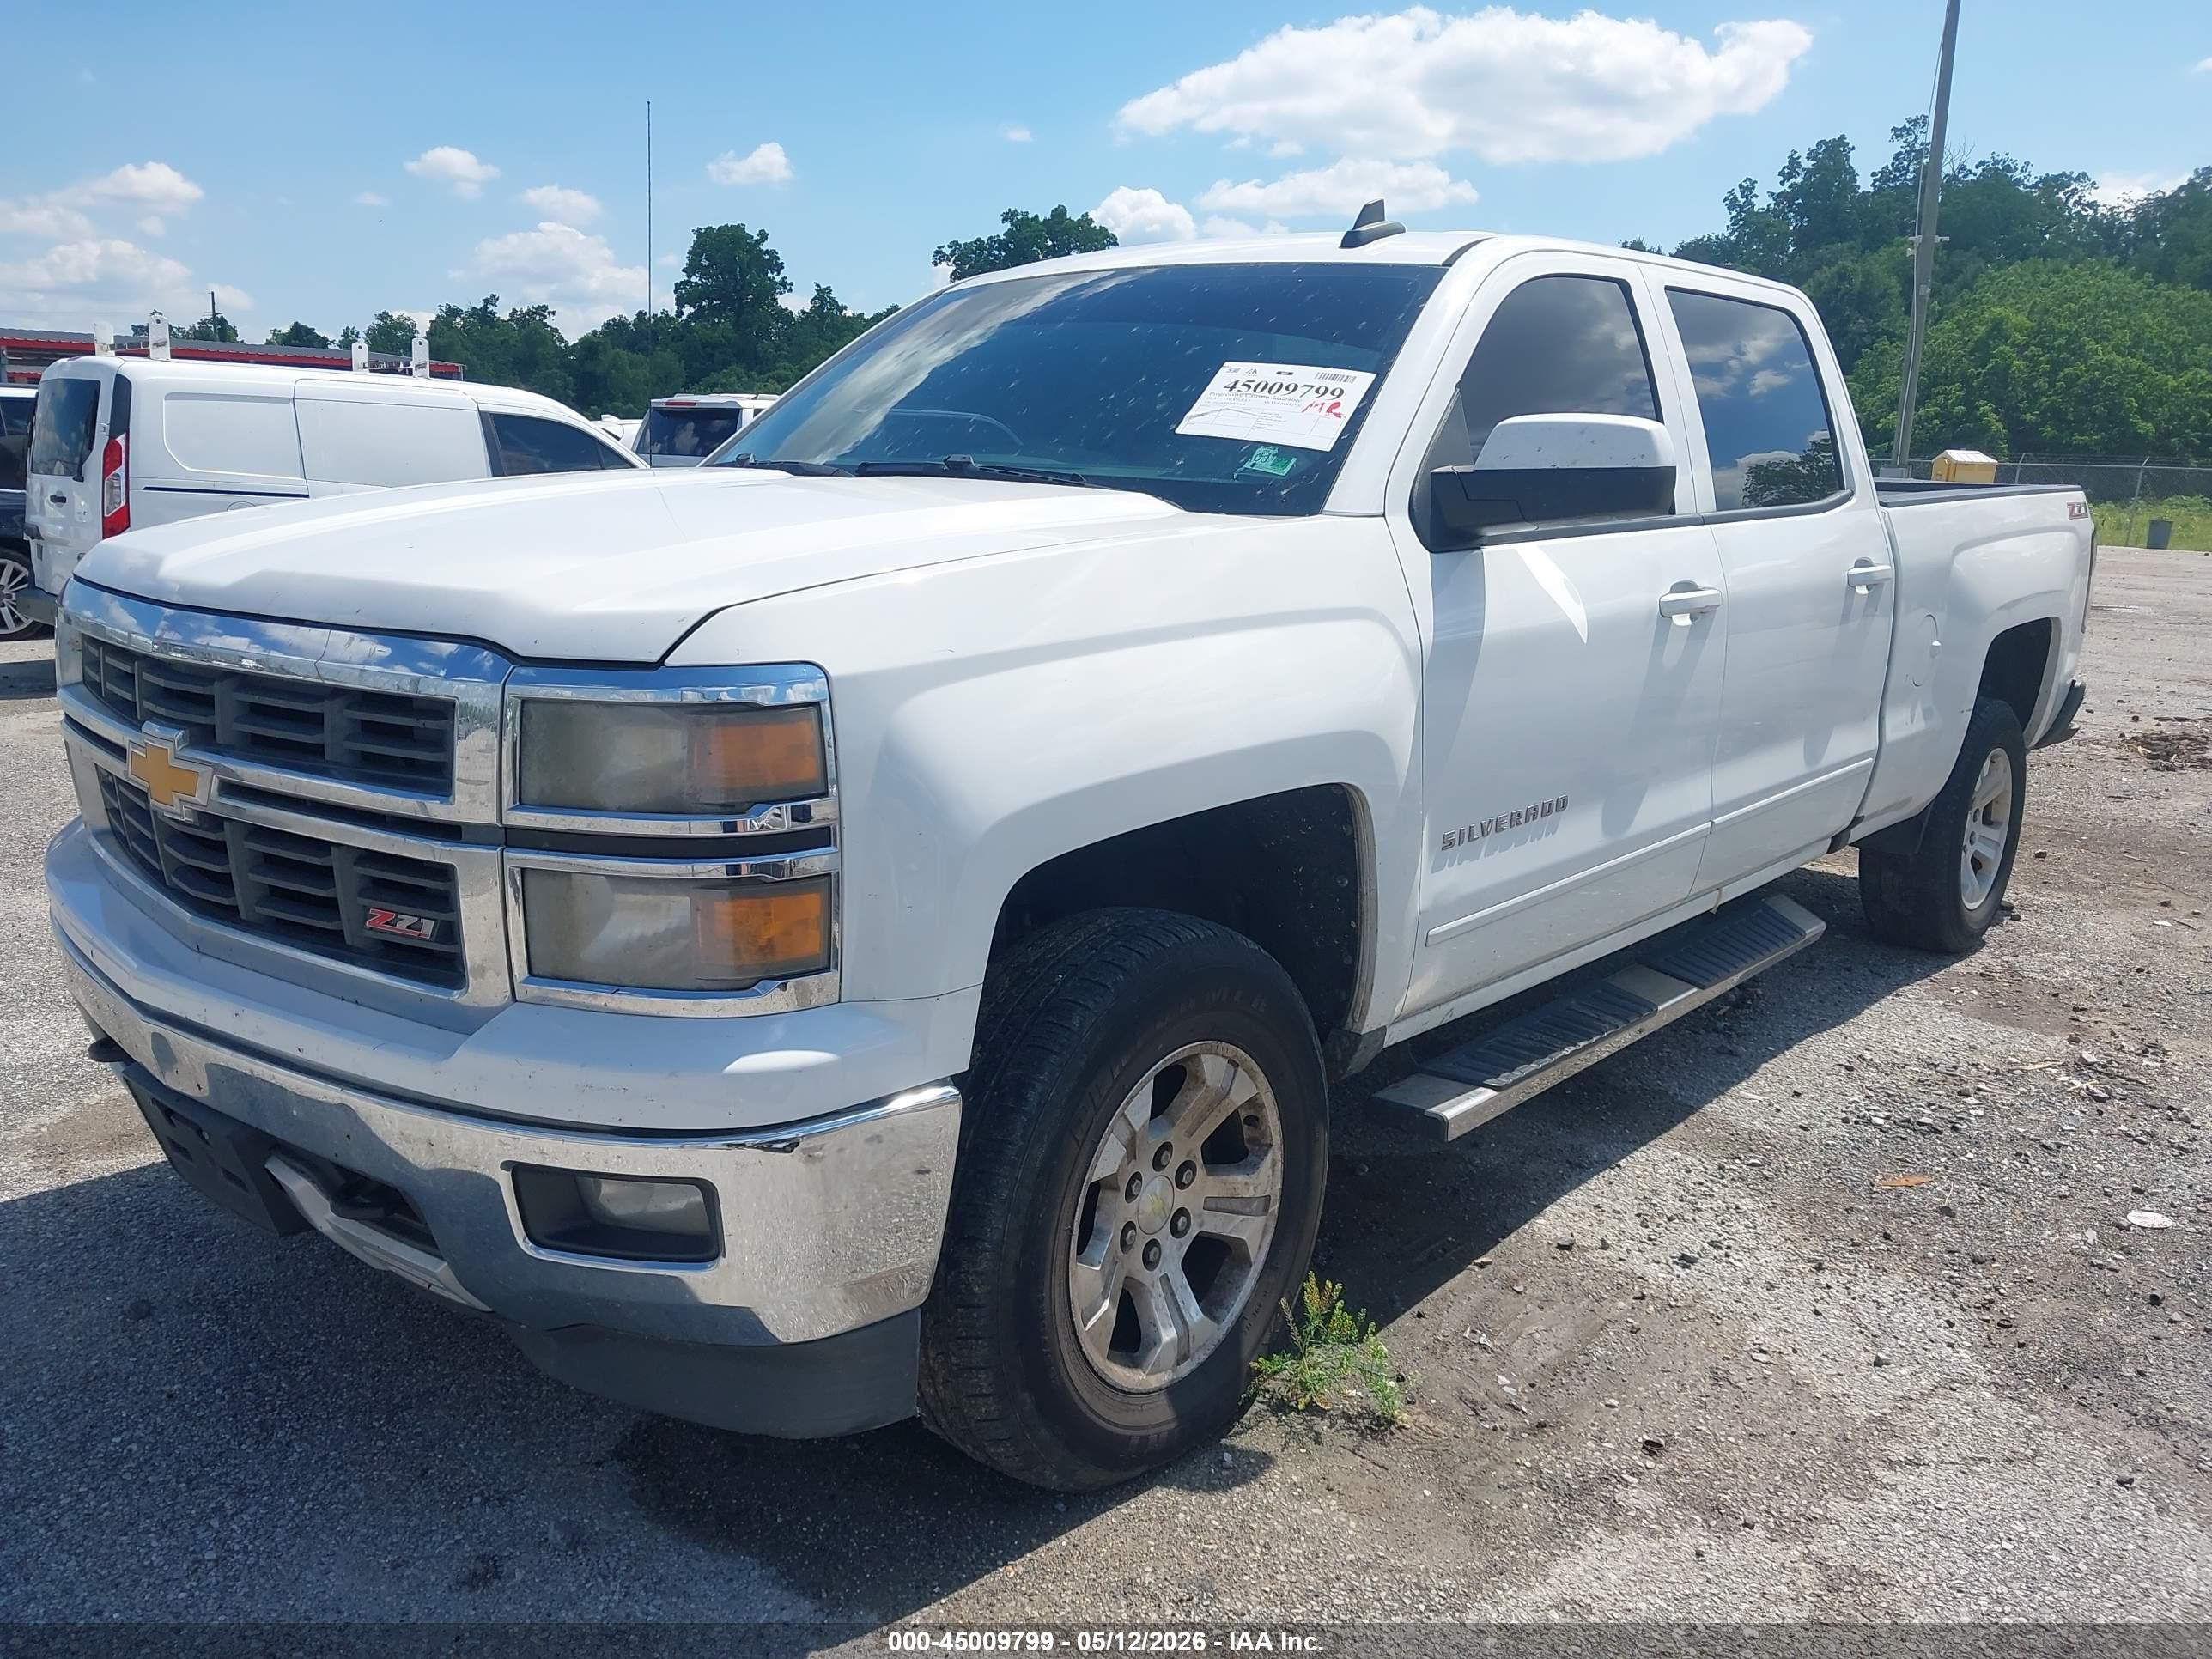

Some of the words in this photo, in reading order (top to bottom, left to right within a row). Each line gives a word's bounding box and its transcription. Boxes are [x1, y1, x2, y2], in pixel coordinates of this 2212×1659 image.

[1223, 379, 1345, 401] 45009799
[2066, 501, 2089, 520] Z71
[1441, 794, 1569, 851] SILVERADO
[365, 908, 435, 939] Z71
